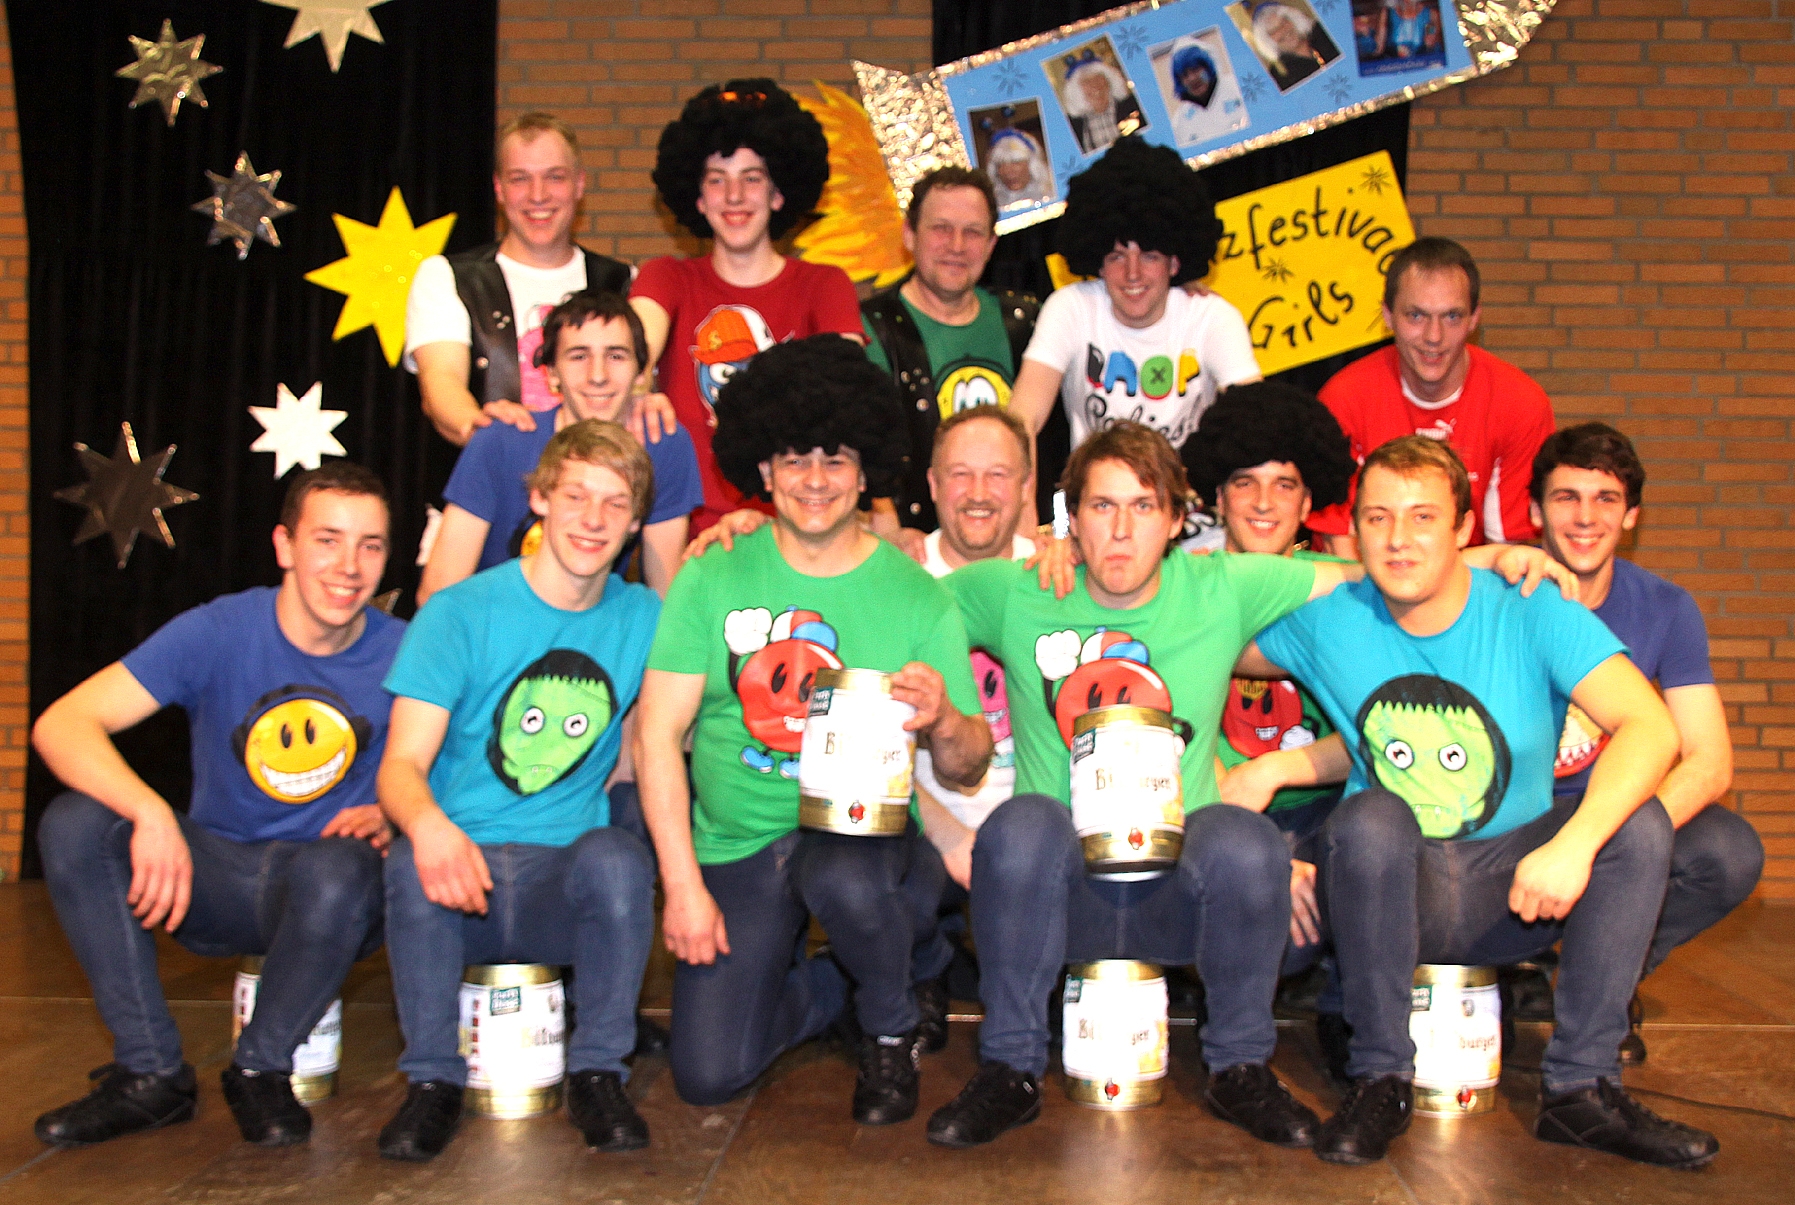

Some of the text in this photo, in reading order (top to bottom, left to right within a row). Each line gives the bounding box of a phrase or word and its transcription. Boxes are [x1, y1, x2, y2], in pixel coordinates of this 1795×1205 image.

[1219, 185, 1398, 276] zfestiva
[1247, 279, 1354, 349] Girls
[1095, 767, 1172, 792] Birger
